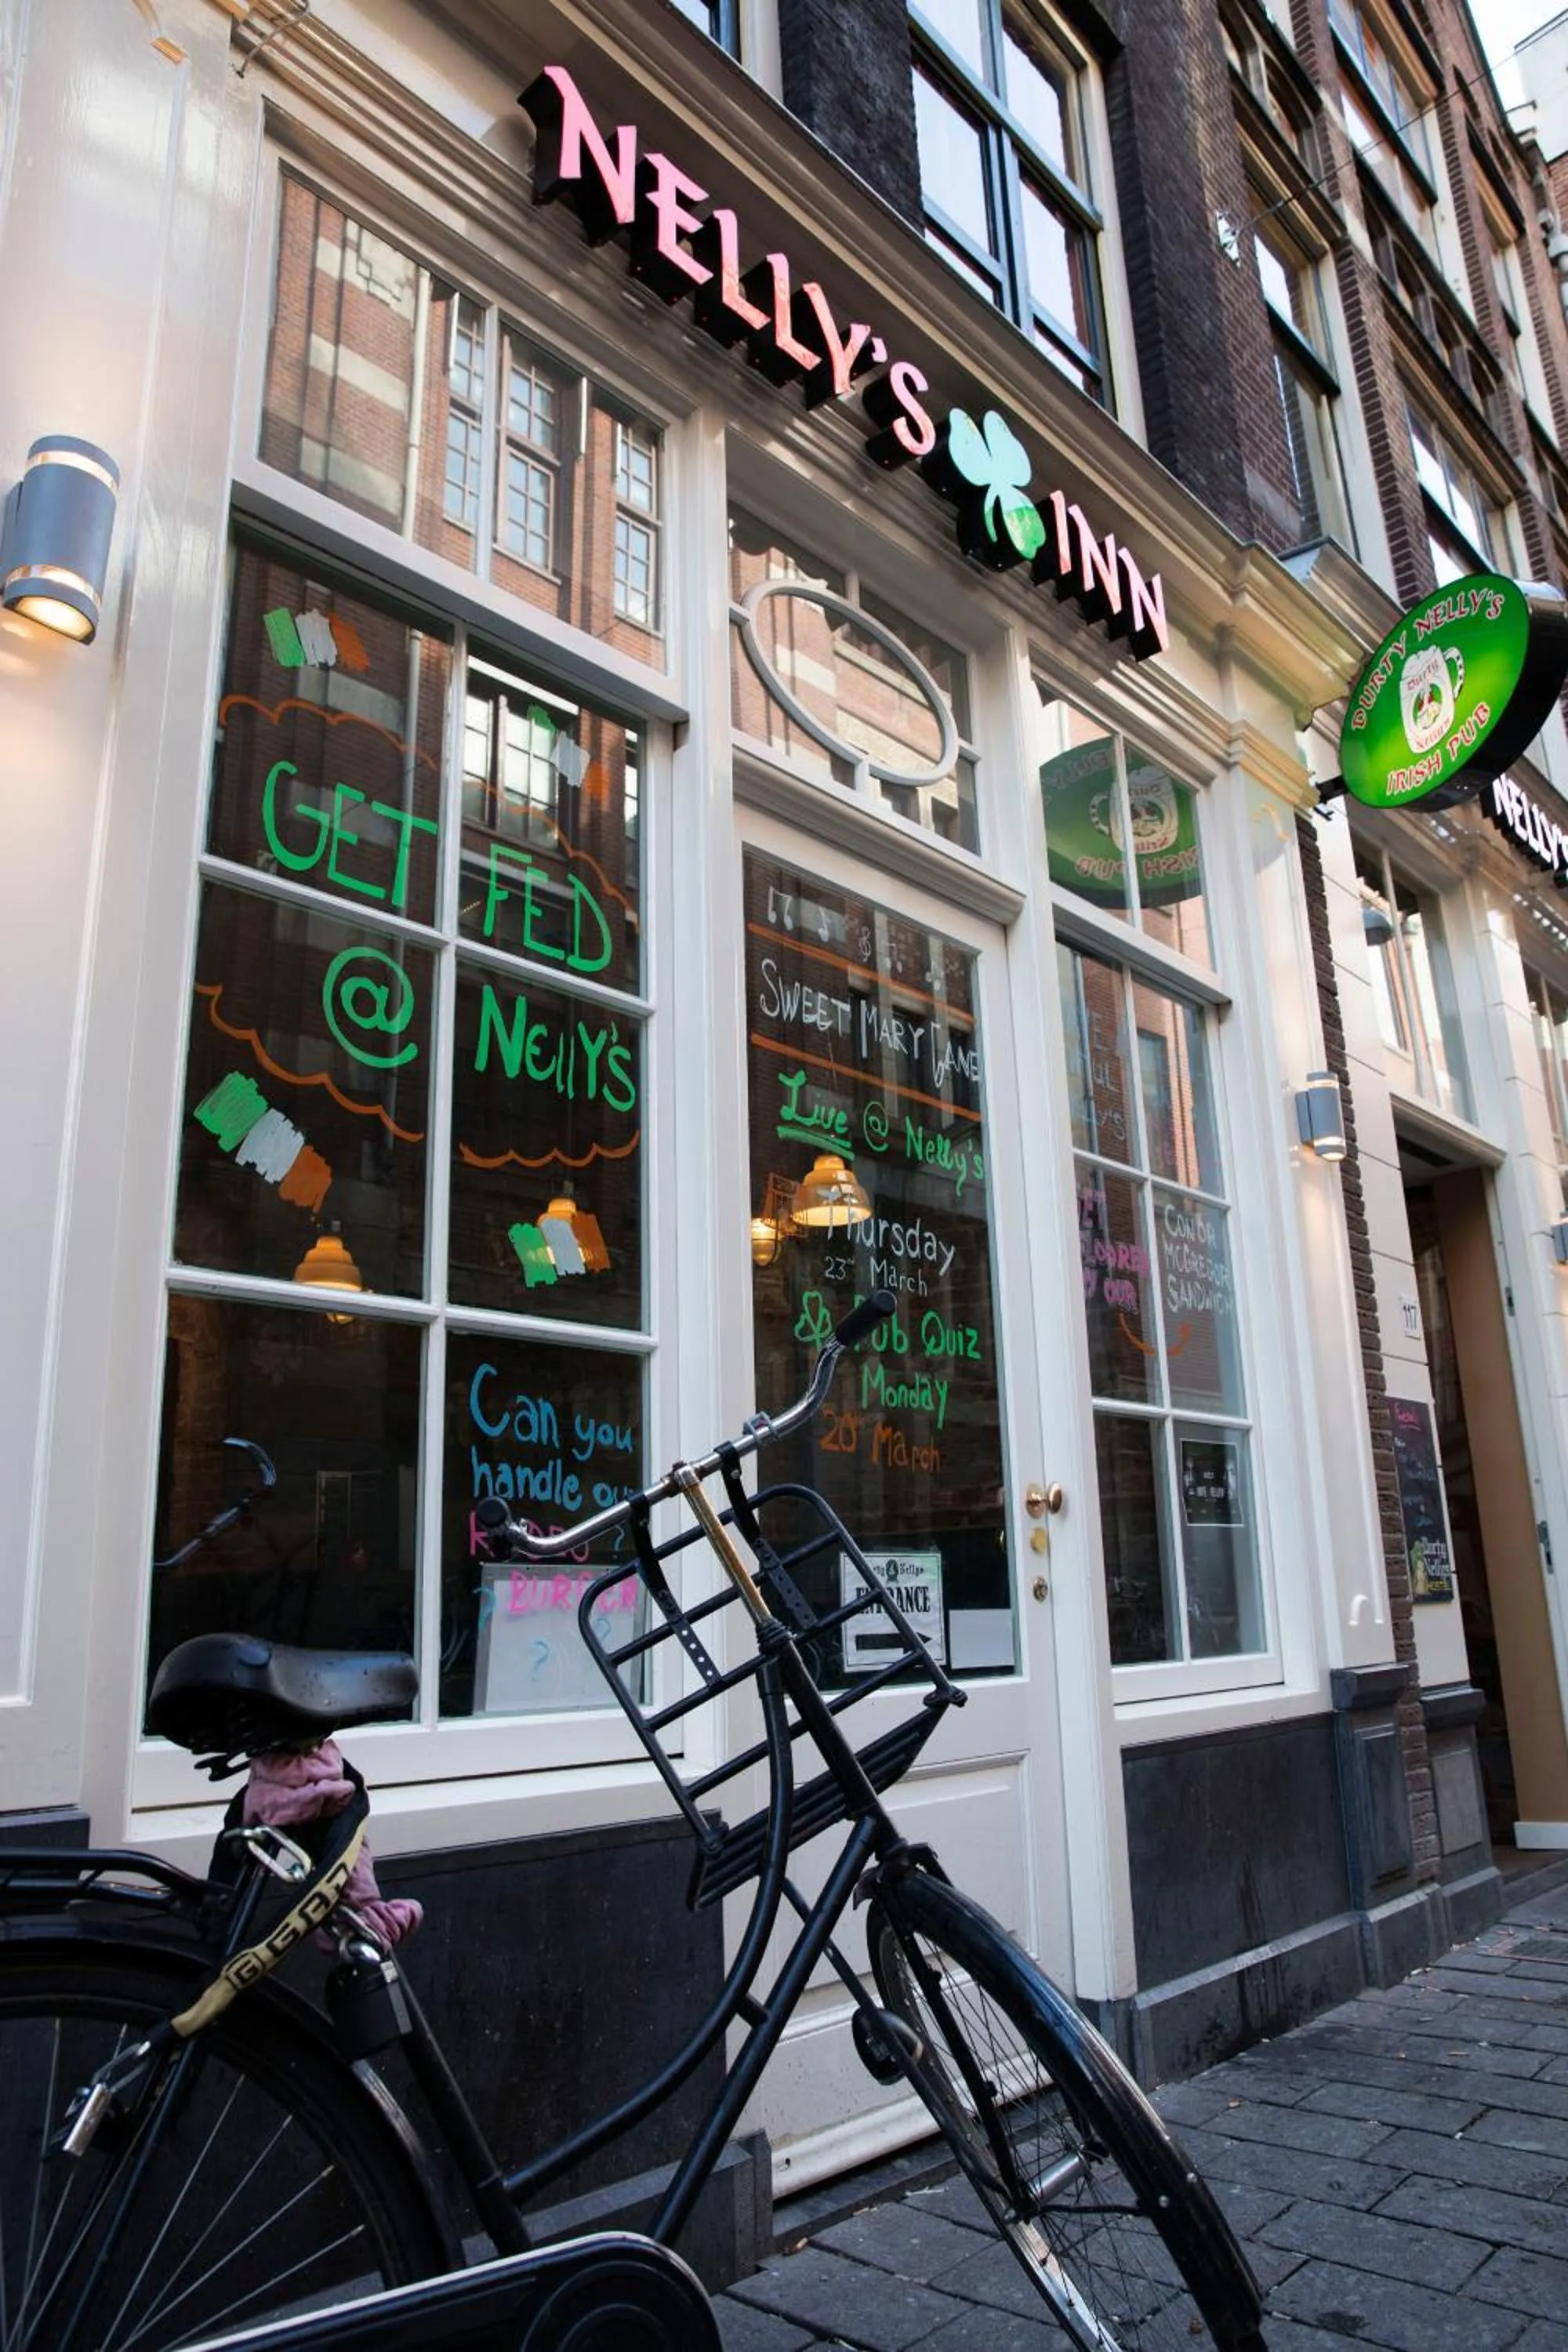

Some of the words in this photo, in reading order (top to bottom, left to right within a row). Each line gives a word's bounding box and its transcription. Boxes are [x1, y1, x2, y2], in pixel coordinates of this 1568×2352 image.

[544, 65, 936, 456] NELLY'S
[1051, 489, 1171, 653] INN
[1352, 631, 1408, 730] DURTY
[1414, 588, 1504, 641] NELLY'S
[1386, 751, 1442, 797] IRISH
[1447, 702, 1490, 760] PUB
[262, 760, 437, 907] GET
[484, 843, 612, 973] FED
[322, 946, 419, 1069] @
[760, 958, 851, 1037] SWEET
[861, 998, 924, 1061] MARY
[778, 1069, 848, 1134] Live
[864, 1101, 889, 1152] @
[905, 1116, 984, 1197] Nelly's
[816, 1188, 955, 1276] Thursday
[869, 1255, 927, 1298] March
[854, 1294, 909, 1354] ub
[921, 1310, 982, 1359] Quiz
[470, 1363, 560, 1450] Can
[572, 1413, 633, 1461] you
[862, 1363, 948, 1430] Monday
[471, 1445, 583, 1512] handle
[593, 1481, 633, 1508] ou
[872, 1421, 940, 1472] March
